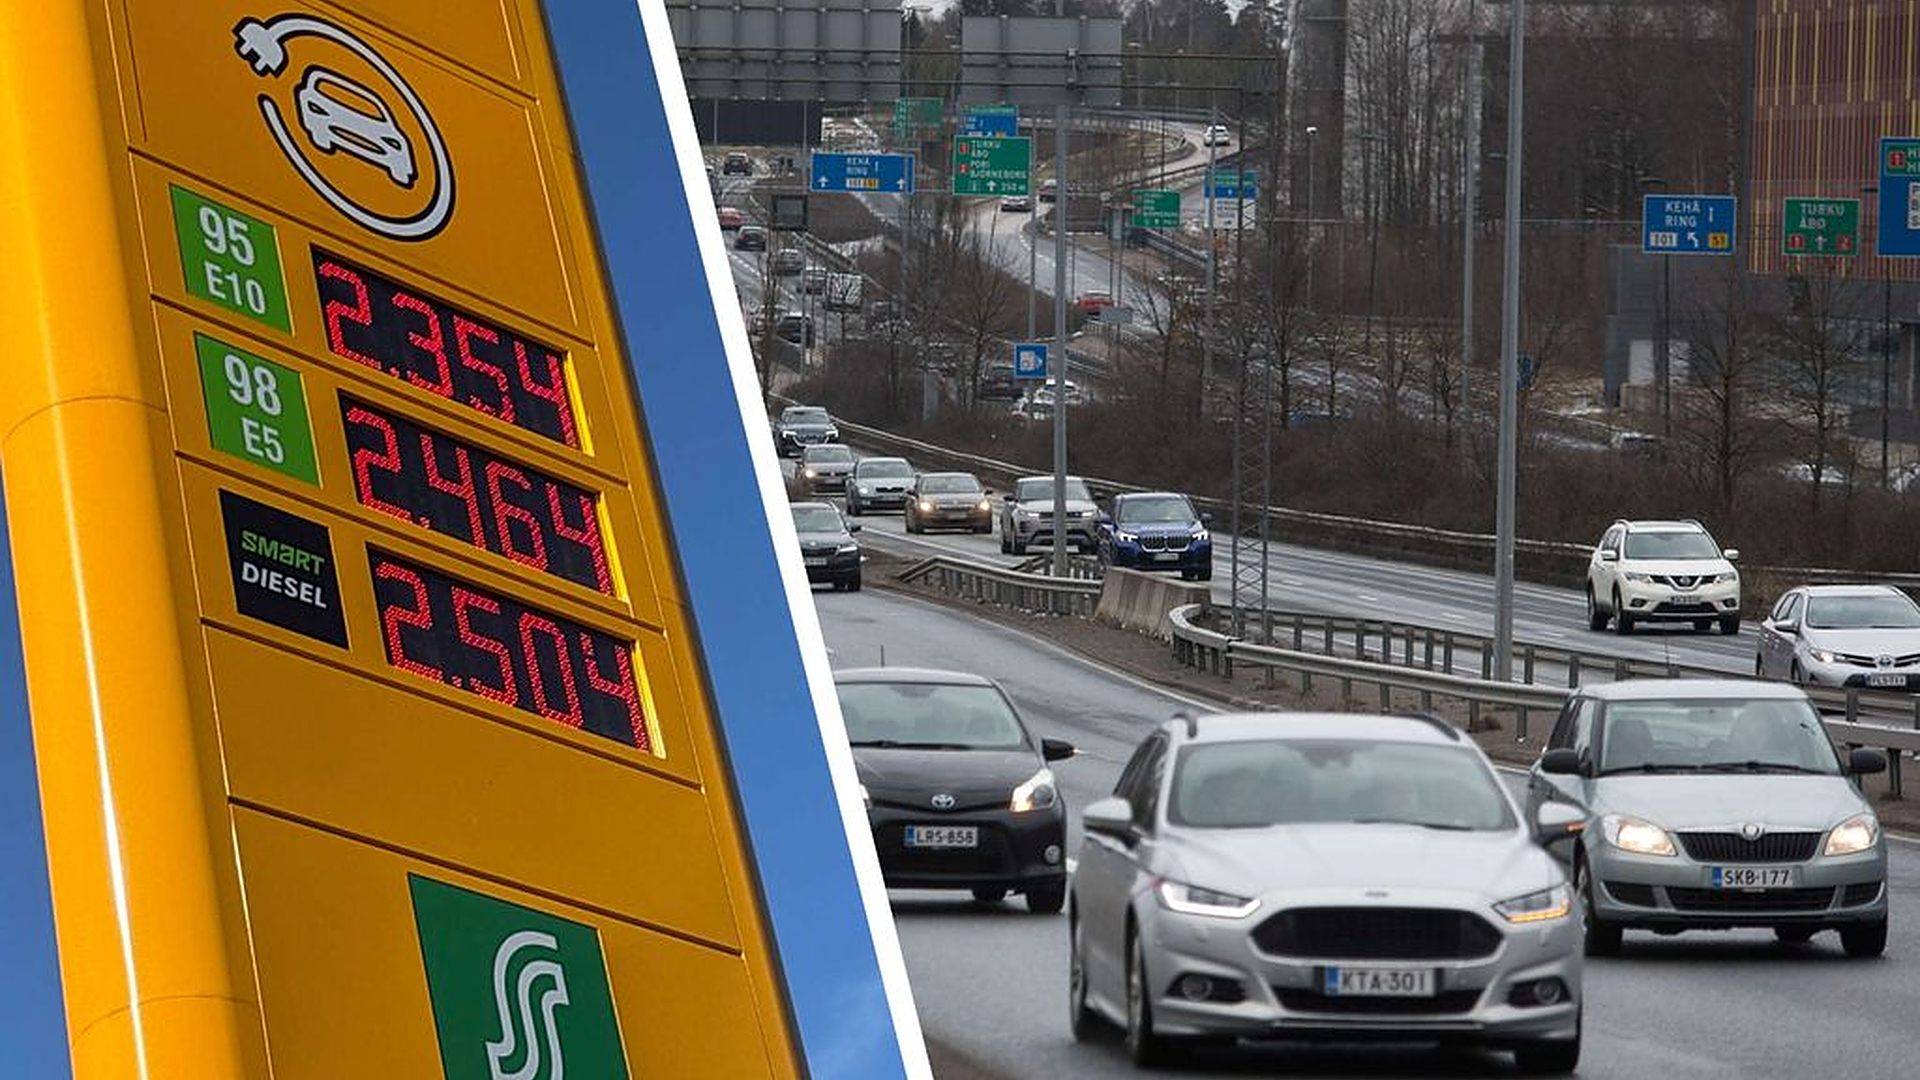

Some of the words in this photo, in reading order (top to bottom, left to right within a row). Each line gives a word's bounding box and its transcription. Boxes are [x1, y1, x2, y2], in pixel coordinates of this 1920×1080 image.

[1665, 215, 1697, 227] RING
[1800, 203, 1845, 216] TURKU
[199, 205, 254, 266] 95
[203, 260, 265, 315] E10
[319, 261, 577, 450] 2.354
[224, 353, 282, 416] 98
[240, 417, 284, 464] E5
[347, 407, 615, 598] 2.464
[241, 562, 328, 609] DIESEL
[375, 562, 649, 752] 2.504
[1724, 869, 1790, 885] SKB-177
[1341, 972, 1426, 991] KTA-301
